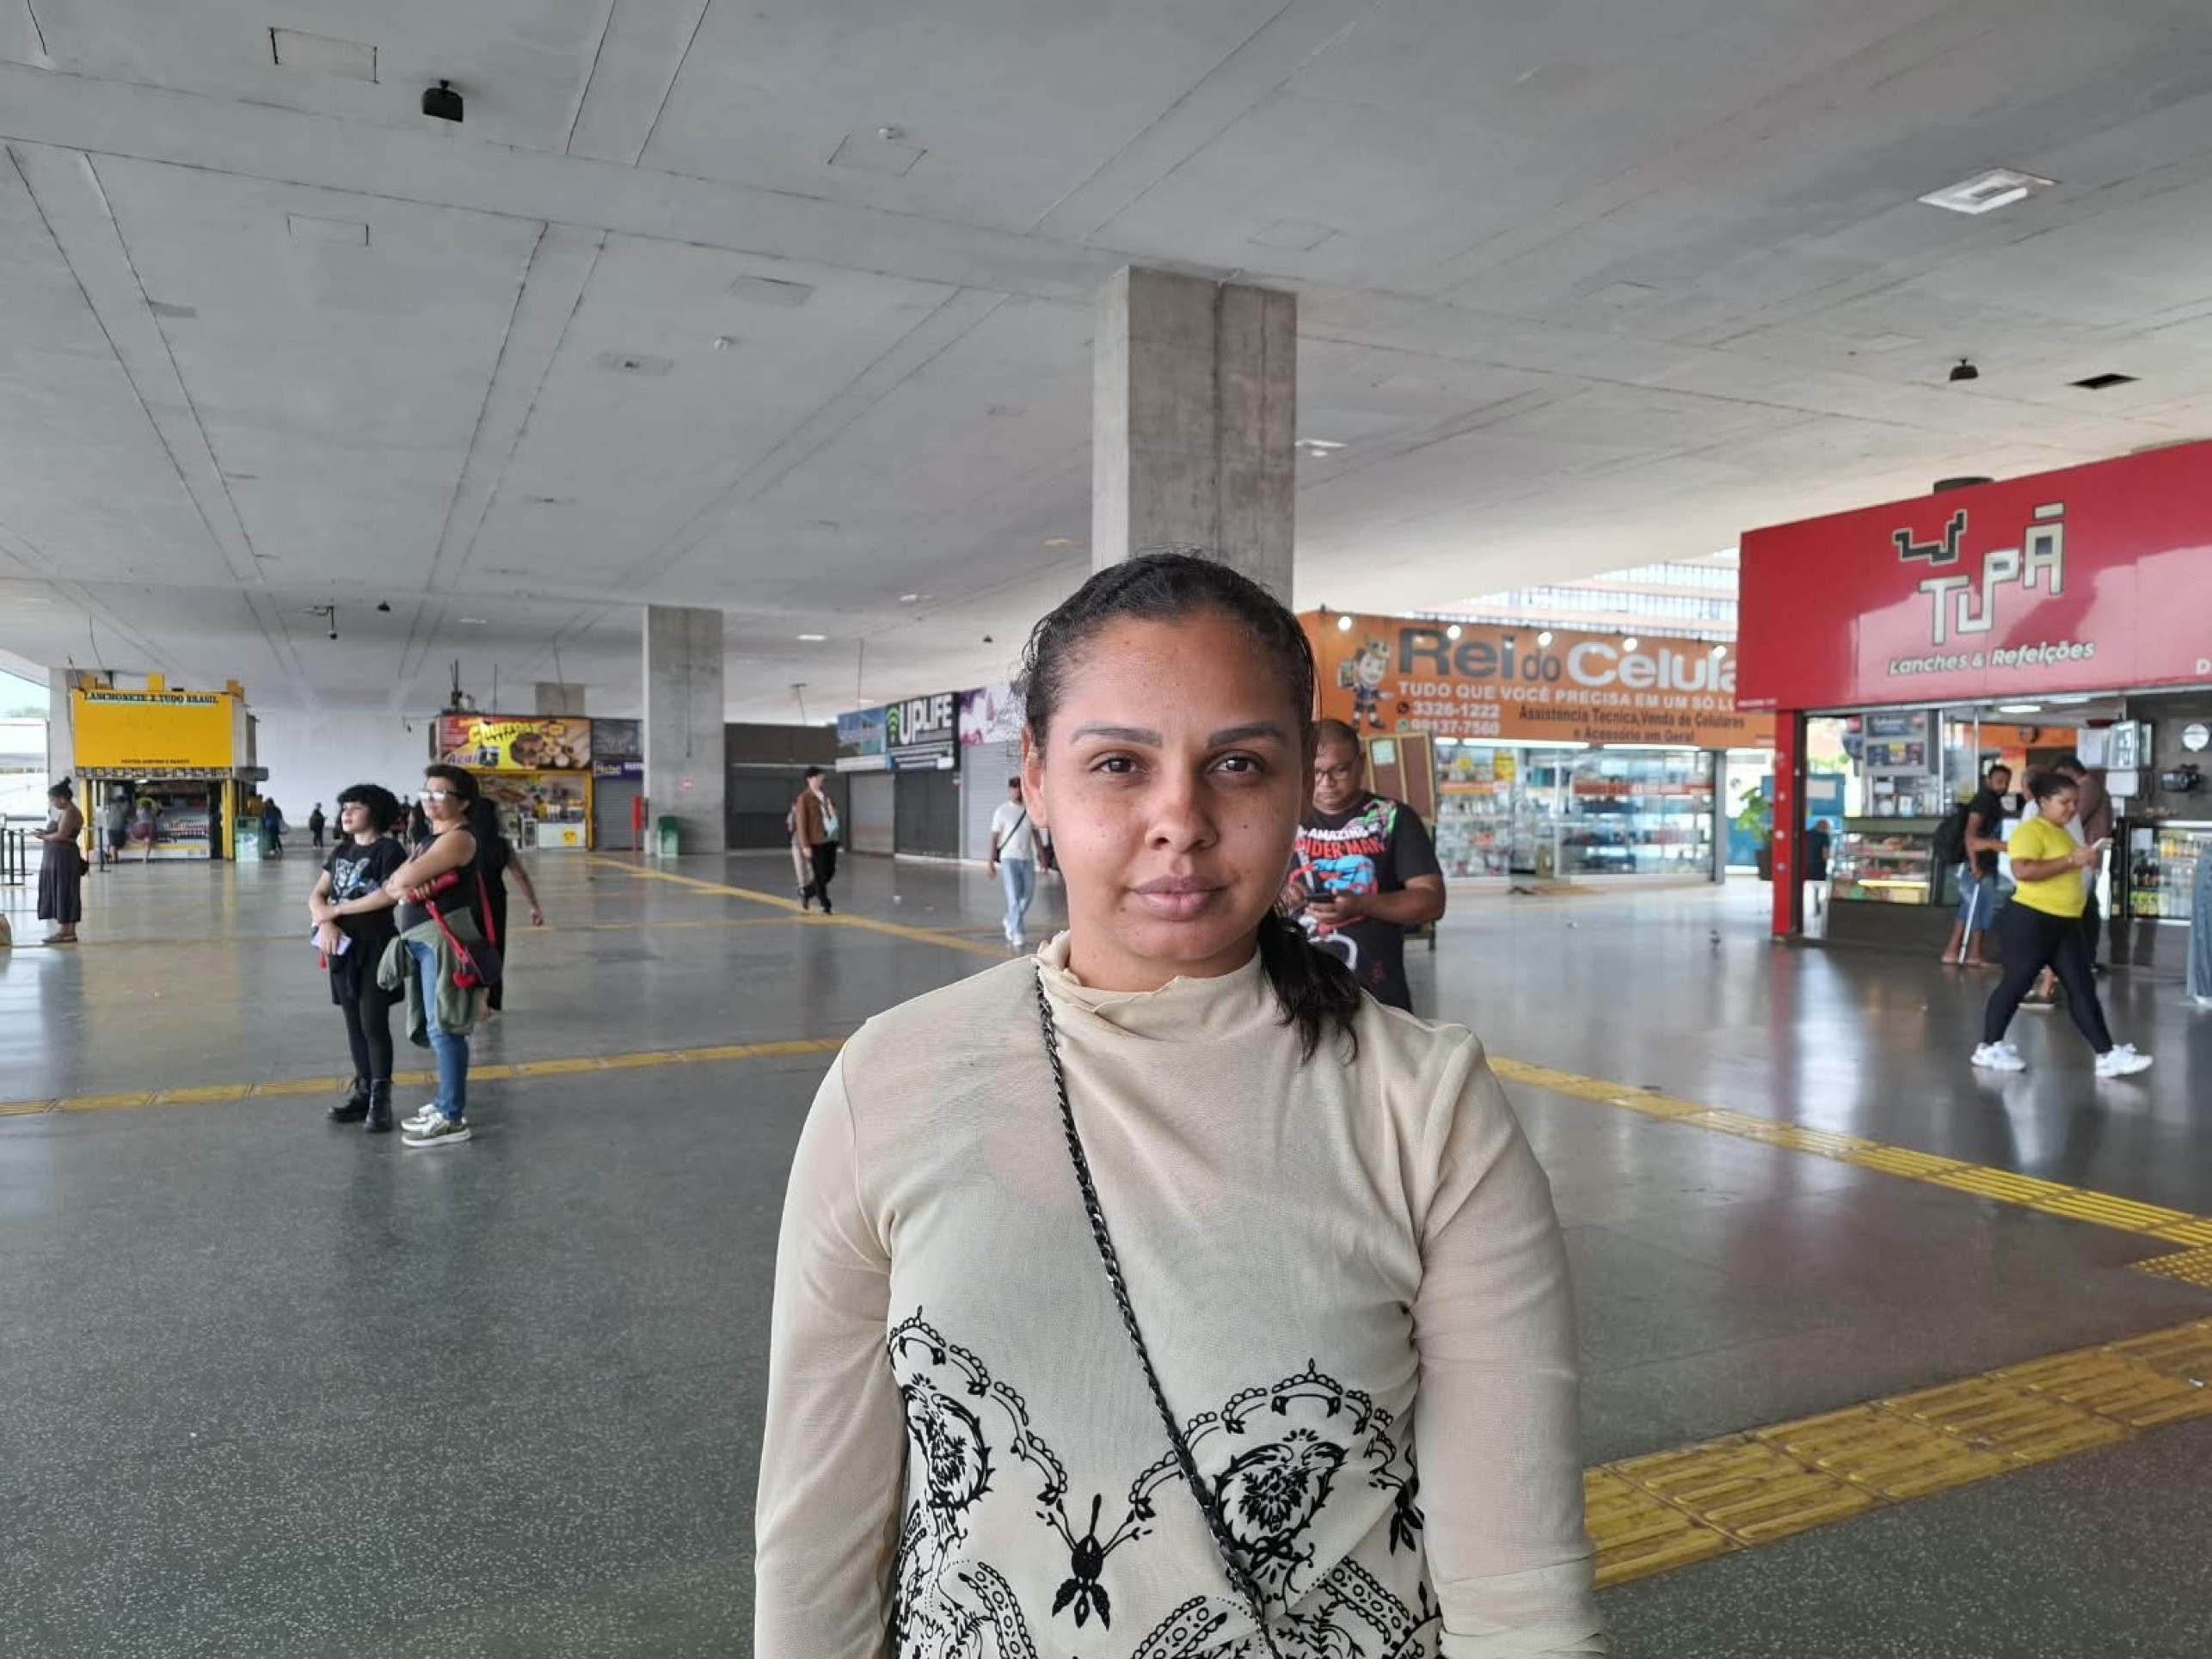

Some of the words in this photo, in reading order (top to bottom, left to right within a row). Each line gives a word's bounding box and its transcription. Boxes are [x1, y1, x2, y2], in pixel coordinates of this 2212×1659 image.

[1919, 503, 2065, 647] TUPÃ
[1399, 627, 1515, 679] Rei
[1522, 648, 1561, 683] do
[1888, 653, 1969, 677] Lanches
[1971, 652, 1985, 669] &
[1991, 641, 2096, 669] Refeições
[1399, 682, 1452, 697] TUDO
[1456, 685, 1495, 699] QUE
[1500, 685, 1549, 702] VOCÊ
[1555, 689, 1630, 707] PRECISA
[1635, 693, 1658, 708] EM
[1664, 695, 1687, 710] UM
